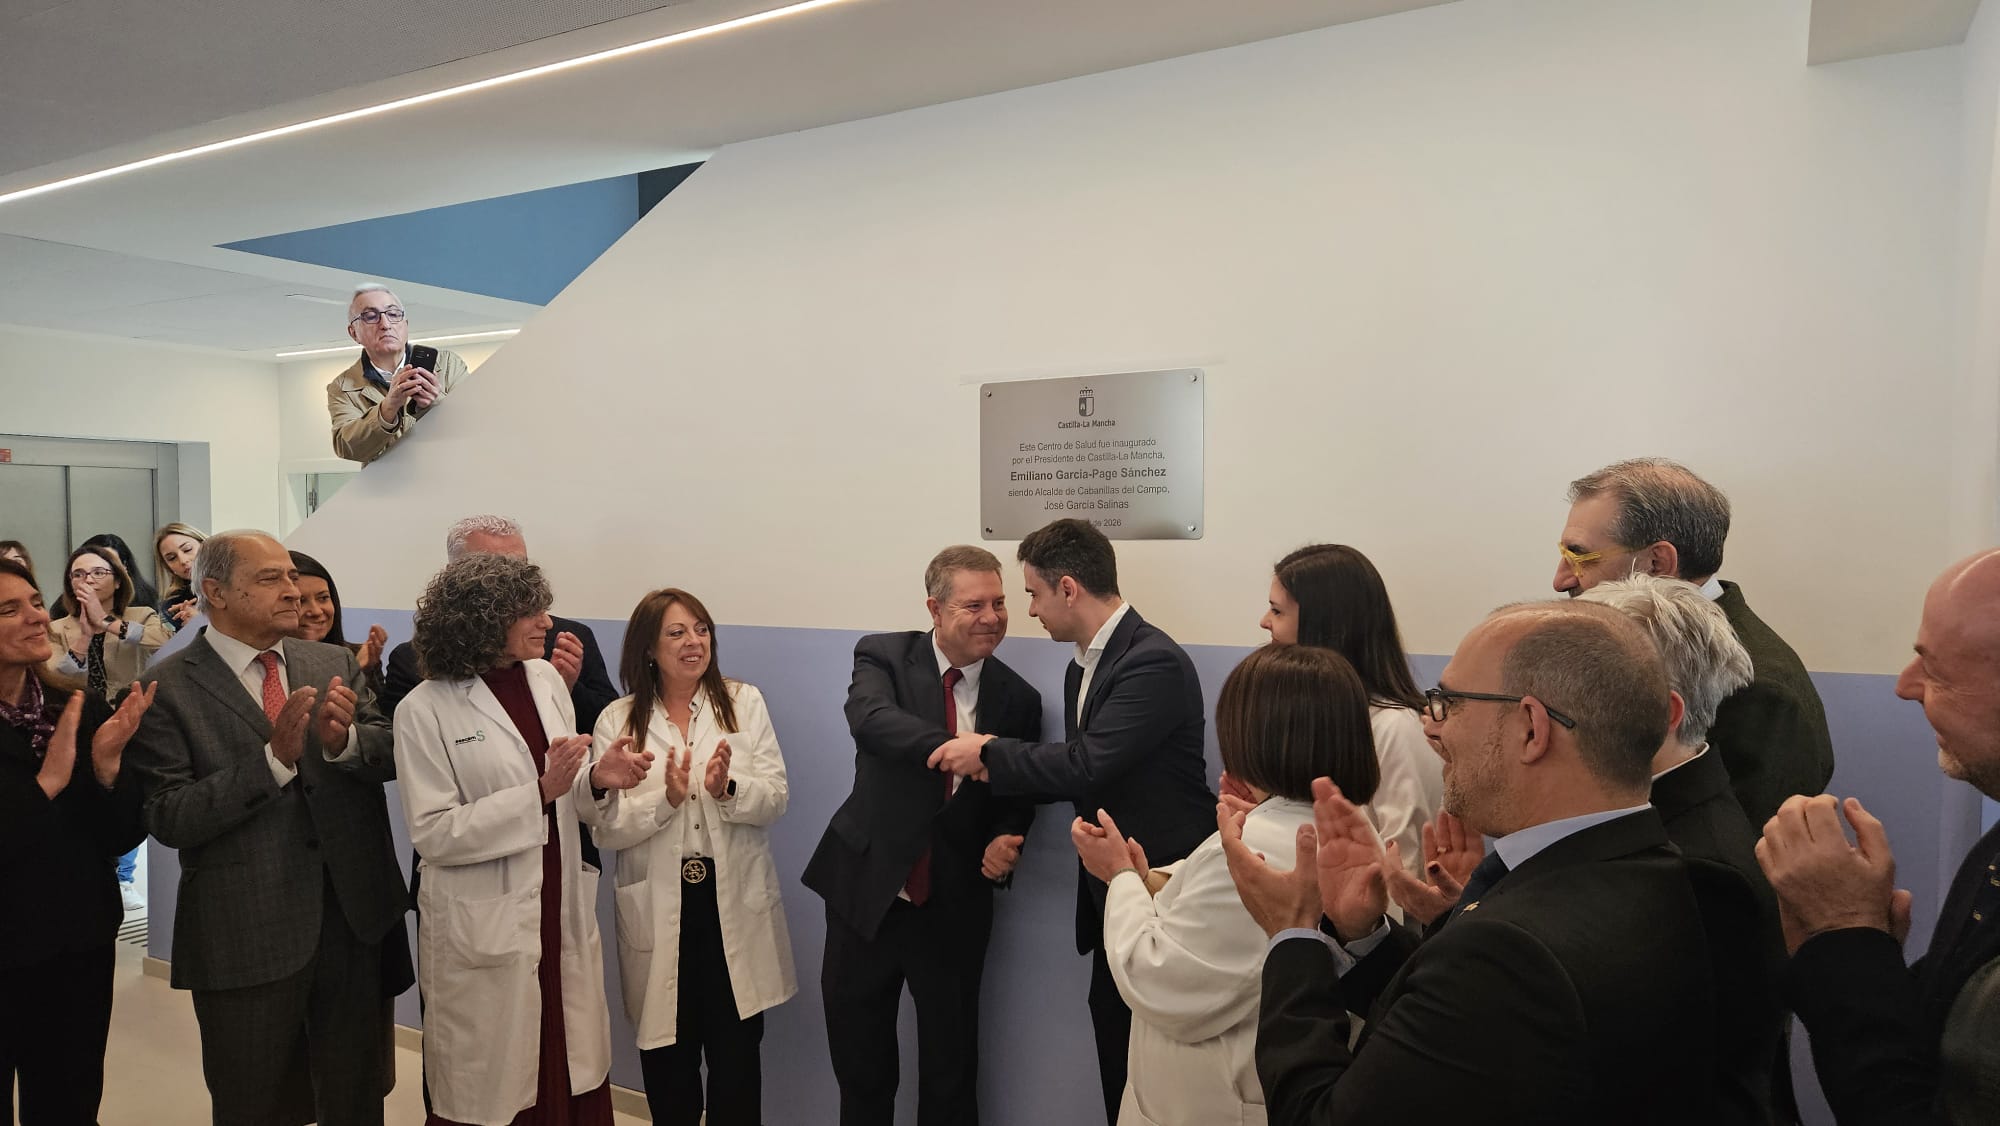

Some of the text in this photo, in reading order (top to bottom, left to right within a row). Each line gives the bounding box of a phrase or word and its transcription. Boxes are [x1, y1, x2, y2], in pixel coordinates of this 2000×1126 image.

[1092, 419, 1116, 427] Mancha
[1019, 438, 1156, 452] Este Centro de Salud fue inaugurado
[1012, 449, 1166, 466] por el Presidente de Castilla-La Mancha,
[1010, 470, 1053, 481] Emiliano
[1120, 466, 1167, 478] Sánchez
[1008, 484, 1170, 497] siendo Alcalde de Cabanillas del Campo,
[1097, 499, 1129, 509] Salinas
[1103, 518, 1122, 527] 2026
